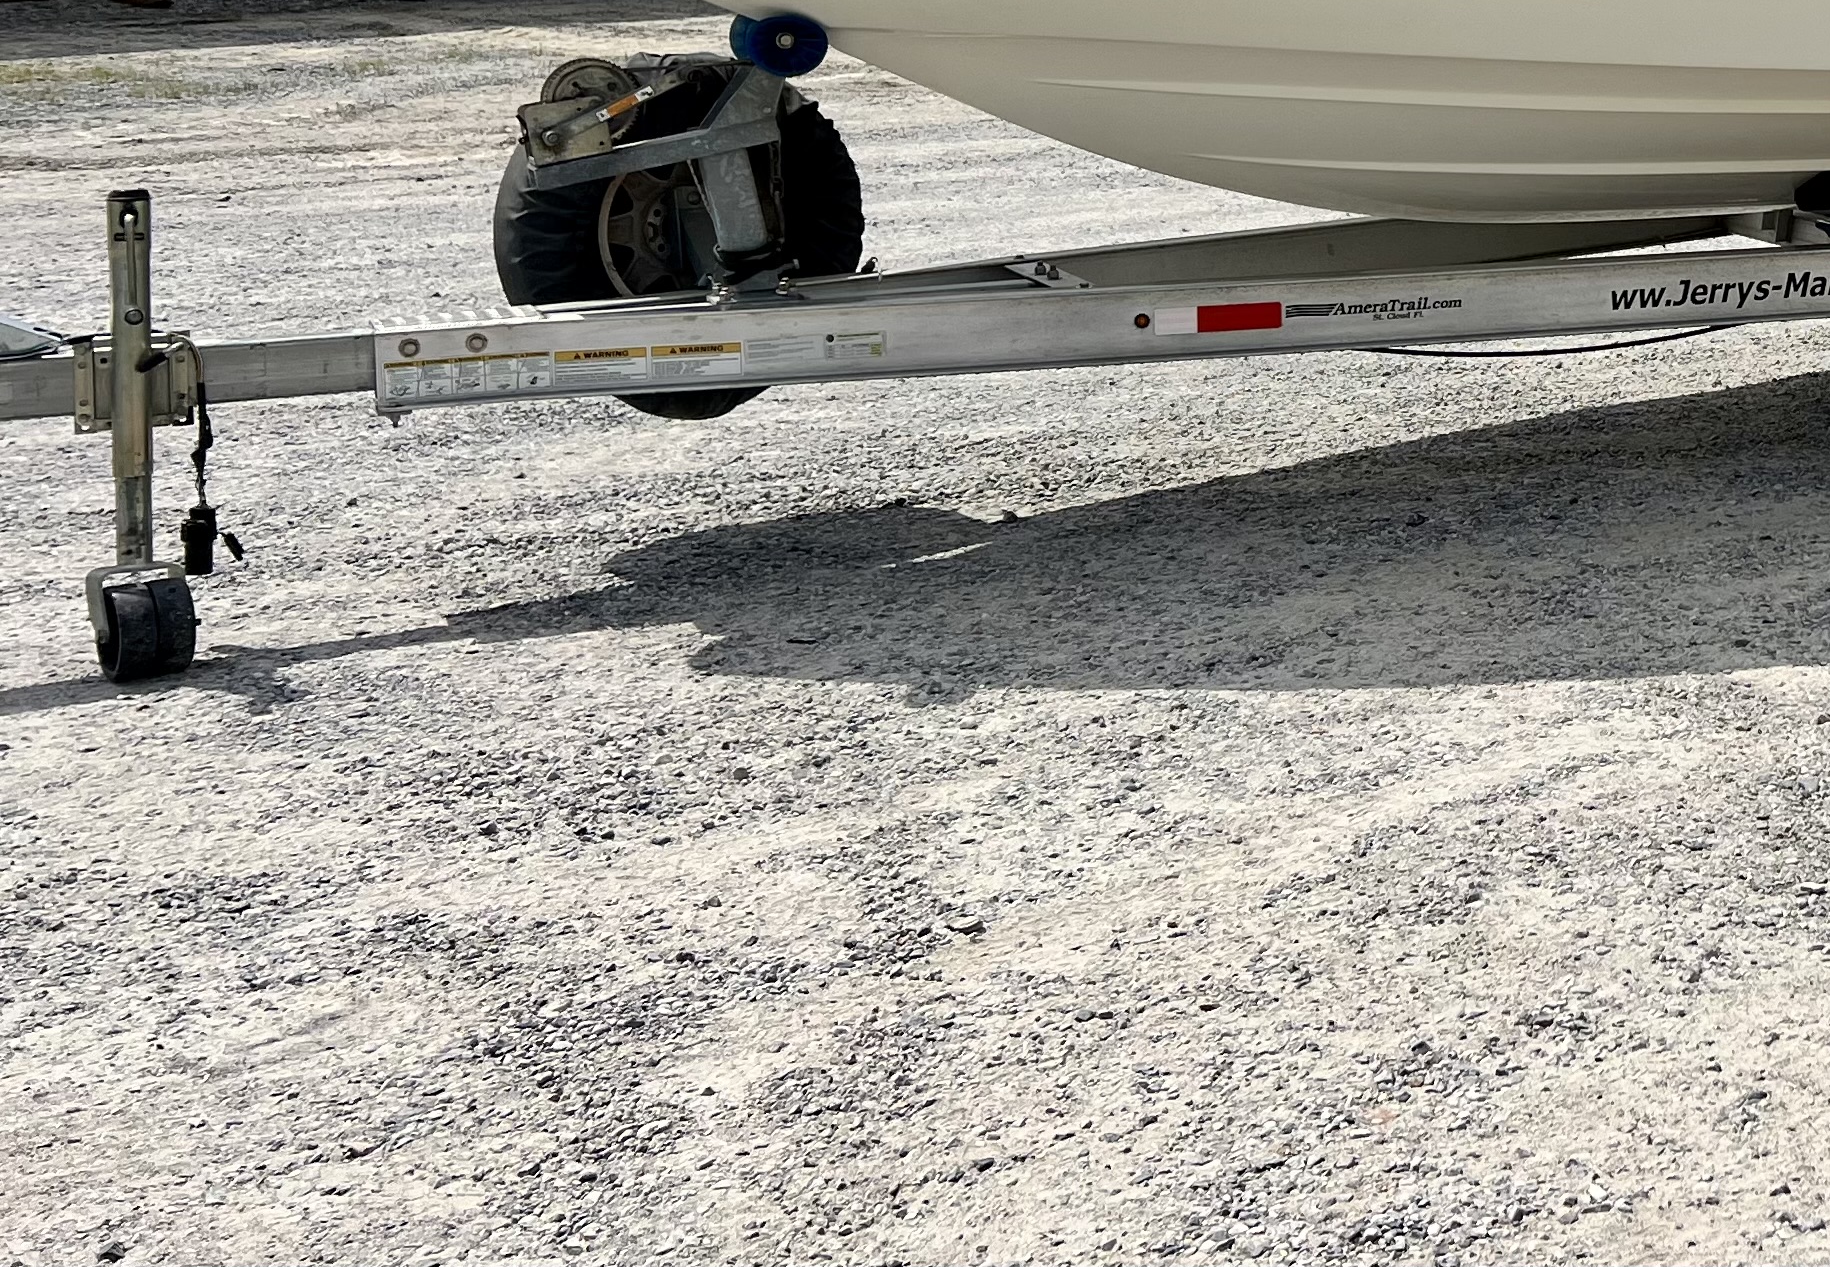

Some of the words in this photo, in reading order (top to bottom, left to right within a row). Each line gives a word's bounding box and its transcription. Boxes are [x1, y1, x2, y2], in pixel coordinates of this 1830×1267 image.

[1331, 296, 1463, 316] AmeraTrail.com
[679, 344, 724, 354] WARNING
[583, 350, 629, 359] WARNING
